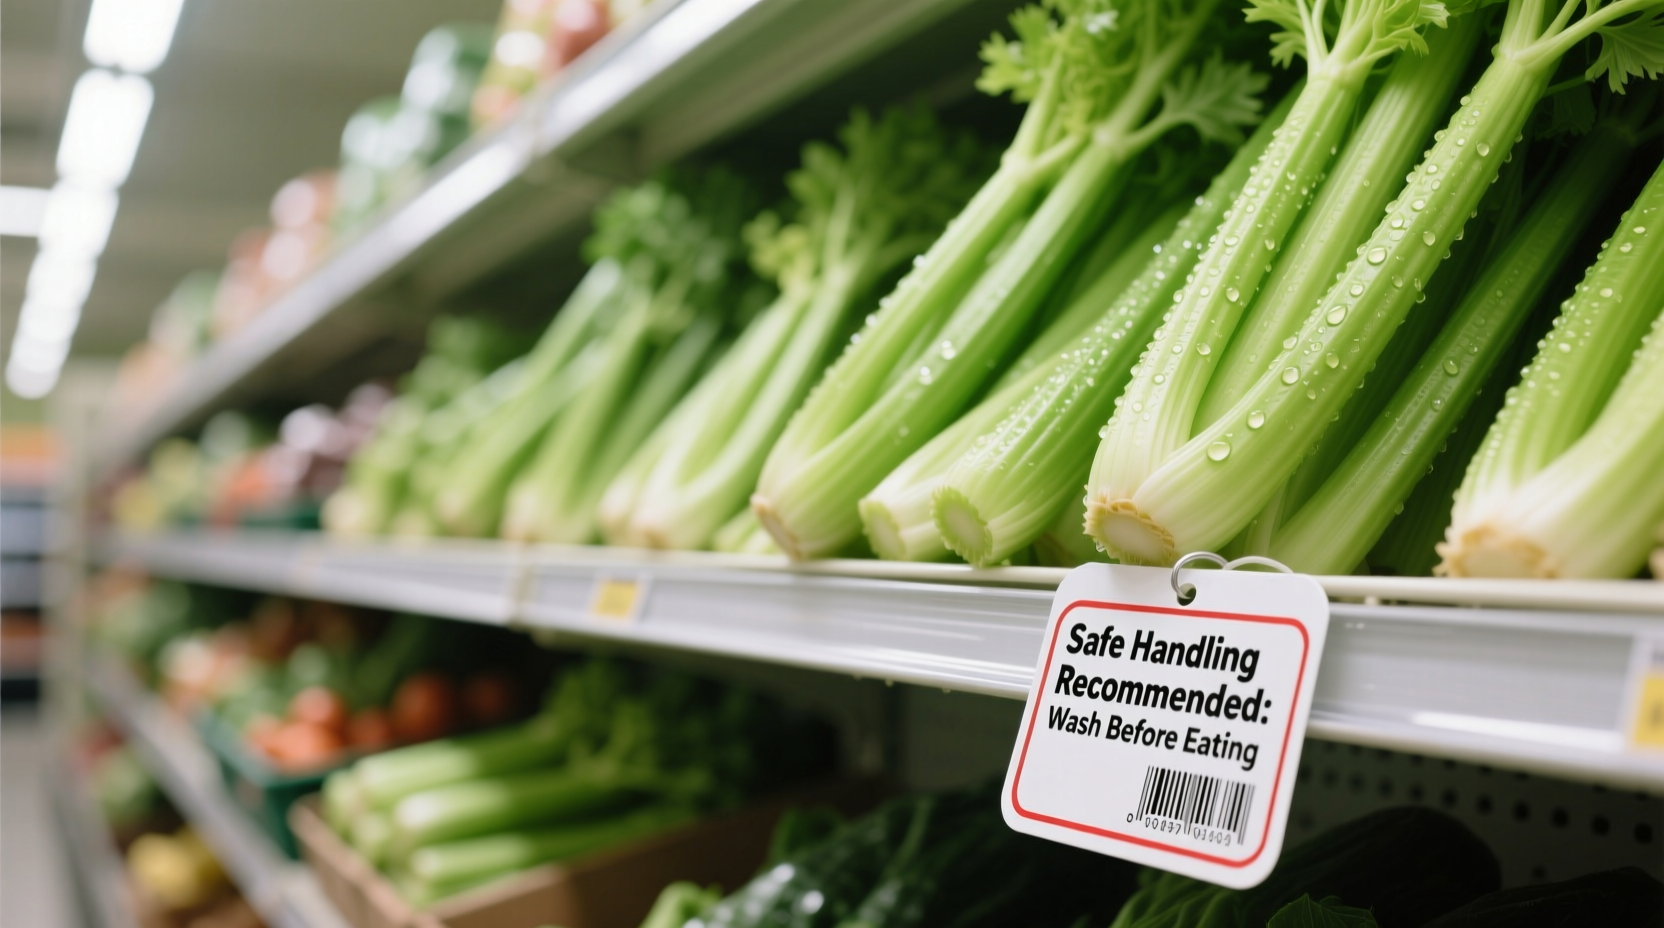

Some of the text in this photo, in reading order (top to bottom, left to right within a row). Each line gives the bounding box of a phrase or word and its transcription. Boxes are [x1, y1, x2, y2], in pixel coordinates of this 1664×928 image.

[1066, 622, 1260, 683] Safe Handling
[1054, 663, 1272, 725] Recommended:
[1048, 705, 1259, 772] Wash Before Eating
